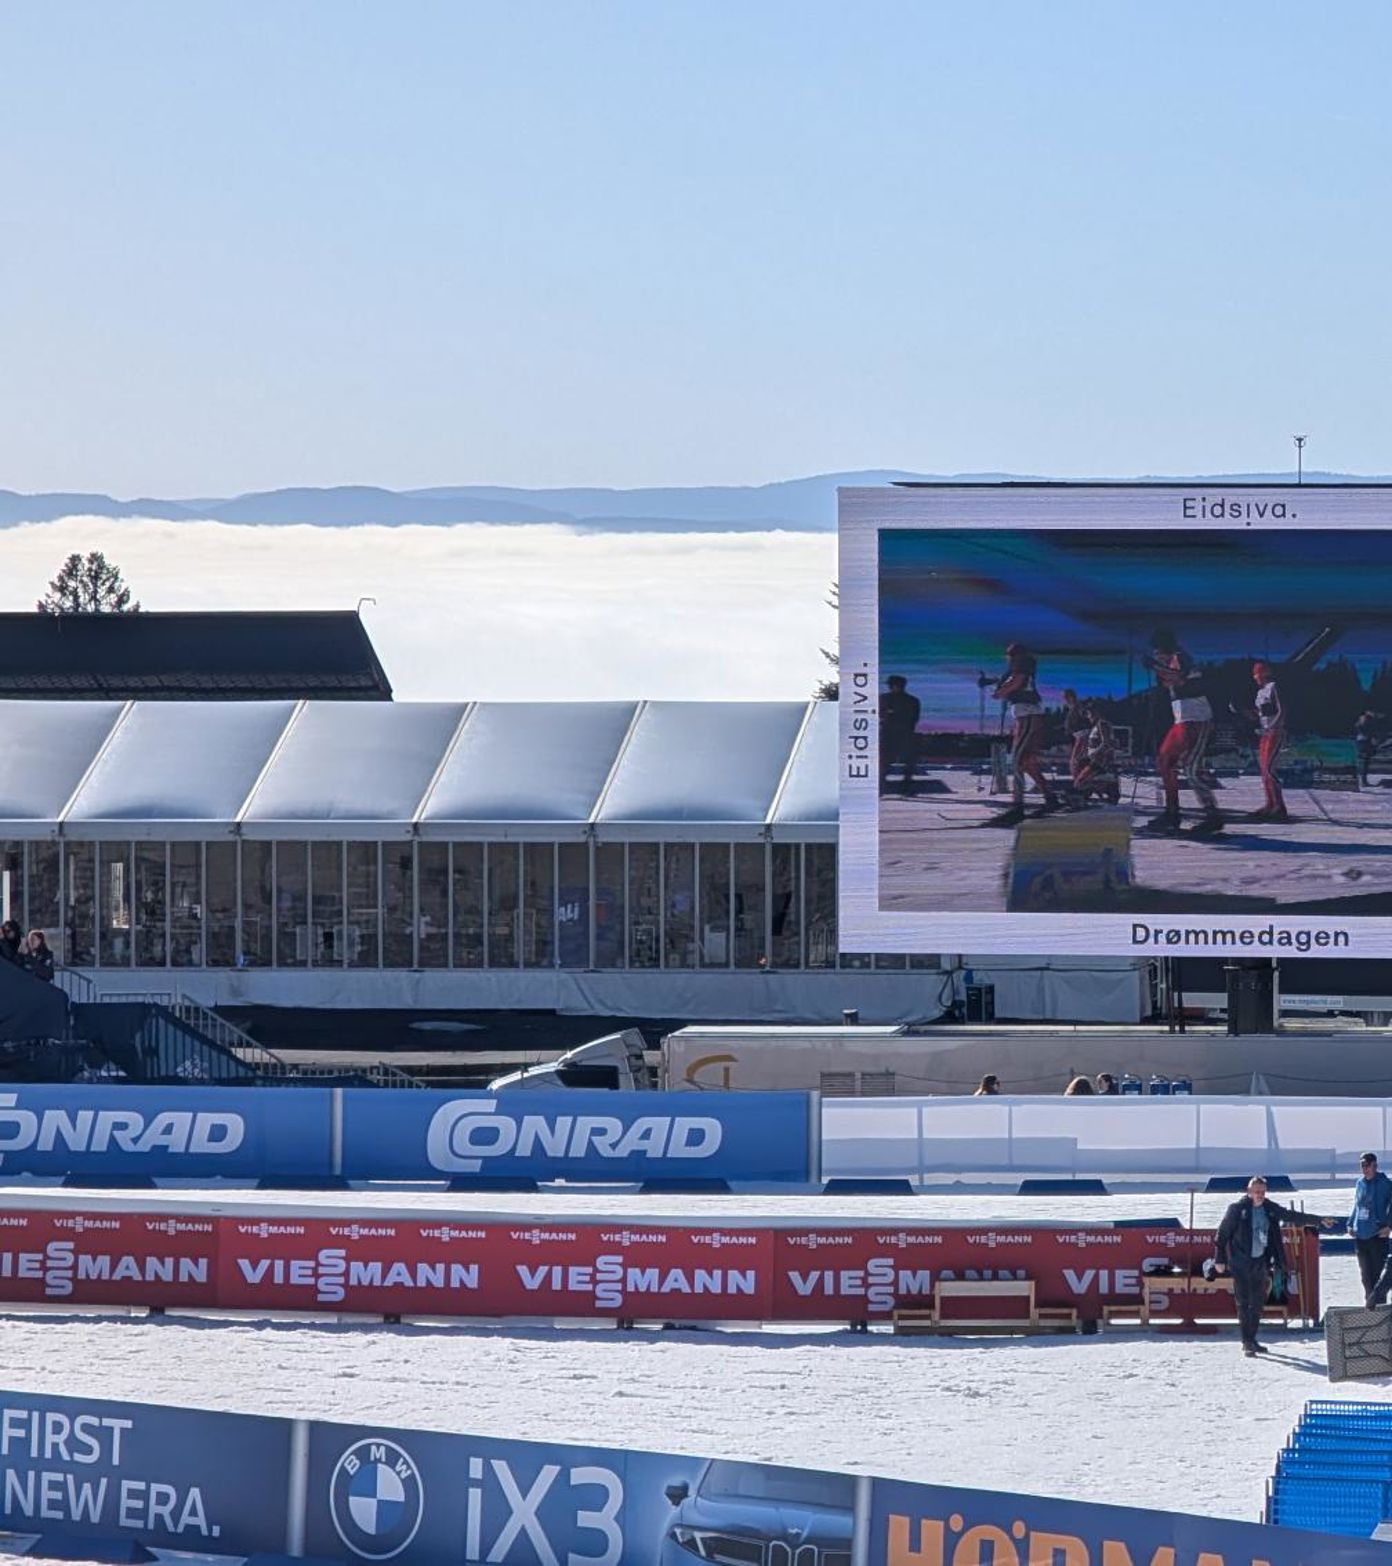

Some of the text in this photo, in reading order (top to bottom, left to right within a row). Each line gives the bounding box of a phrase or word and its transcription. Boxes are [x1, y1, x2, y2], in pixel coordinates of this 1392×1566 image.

[1182, 496, 1298, 526] Eidsiva.
[847, 662, 876, 779] Eidsiva.
[1131, 923, 1350, 952] Drømmedagen
[0, 1093, 244, 1167] ONRAD
[427, 1099, 723, 1172] CONRAD
[54, 1216, 120, 1232] VIESSMANN
[146, 1219, 213, 1235] VIESSMANN
[238, 1223, 305, 1238] VIESSMANN
[329, 1224, 396, 1240] VIESSMANN
[420, 1226, 487, 1242] VIESSMANN
[510, 1229, 577, 1244] VIESSMANN
[600, 1230, 667, 1246] VIESSMANN
[691, 1233, 757, 1248] VIESSMANN
[787, 1233, 853, 1249] VIESSMANN
[876, 1232, 943, 1248] VIESSMANN
[966, 1232, 1033, 1248] VIESSMANN
[1056, 1232, 1122, 1248] VIESSMANN
[1, 1241, 208, 1296] IESSMANN
[236, 1249, 479, 1302] VIESSMANN
[516, 1254, 756, 1308] VIESSMANN
[1, 1408, 134, 1466] FIRST
[343, 1444, 413, 1481] BMW
[4, 1468, 221, 1537] NEW ERA.
[466, 1457, 624, 1566] iX3
